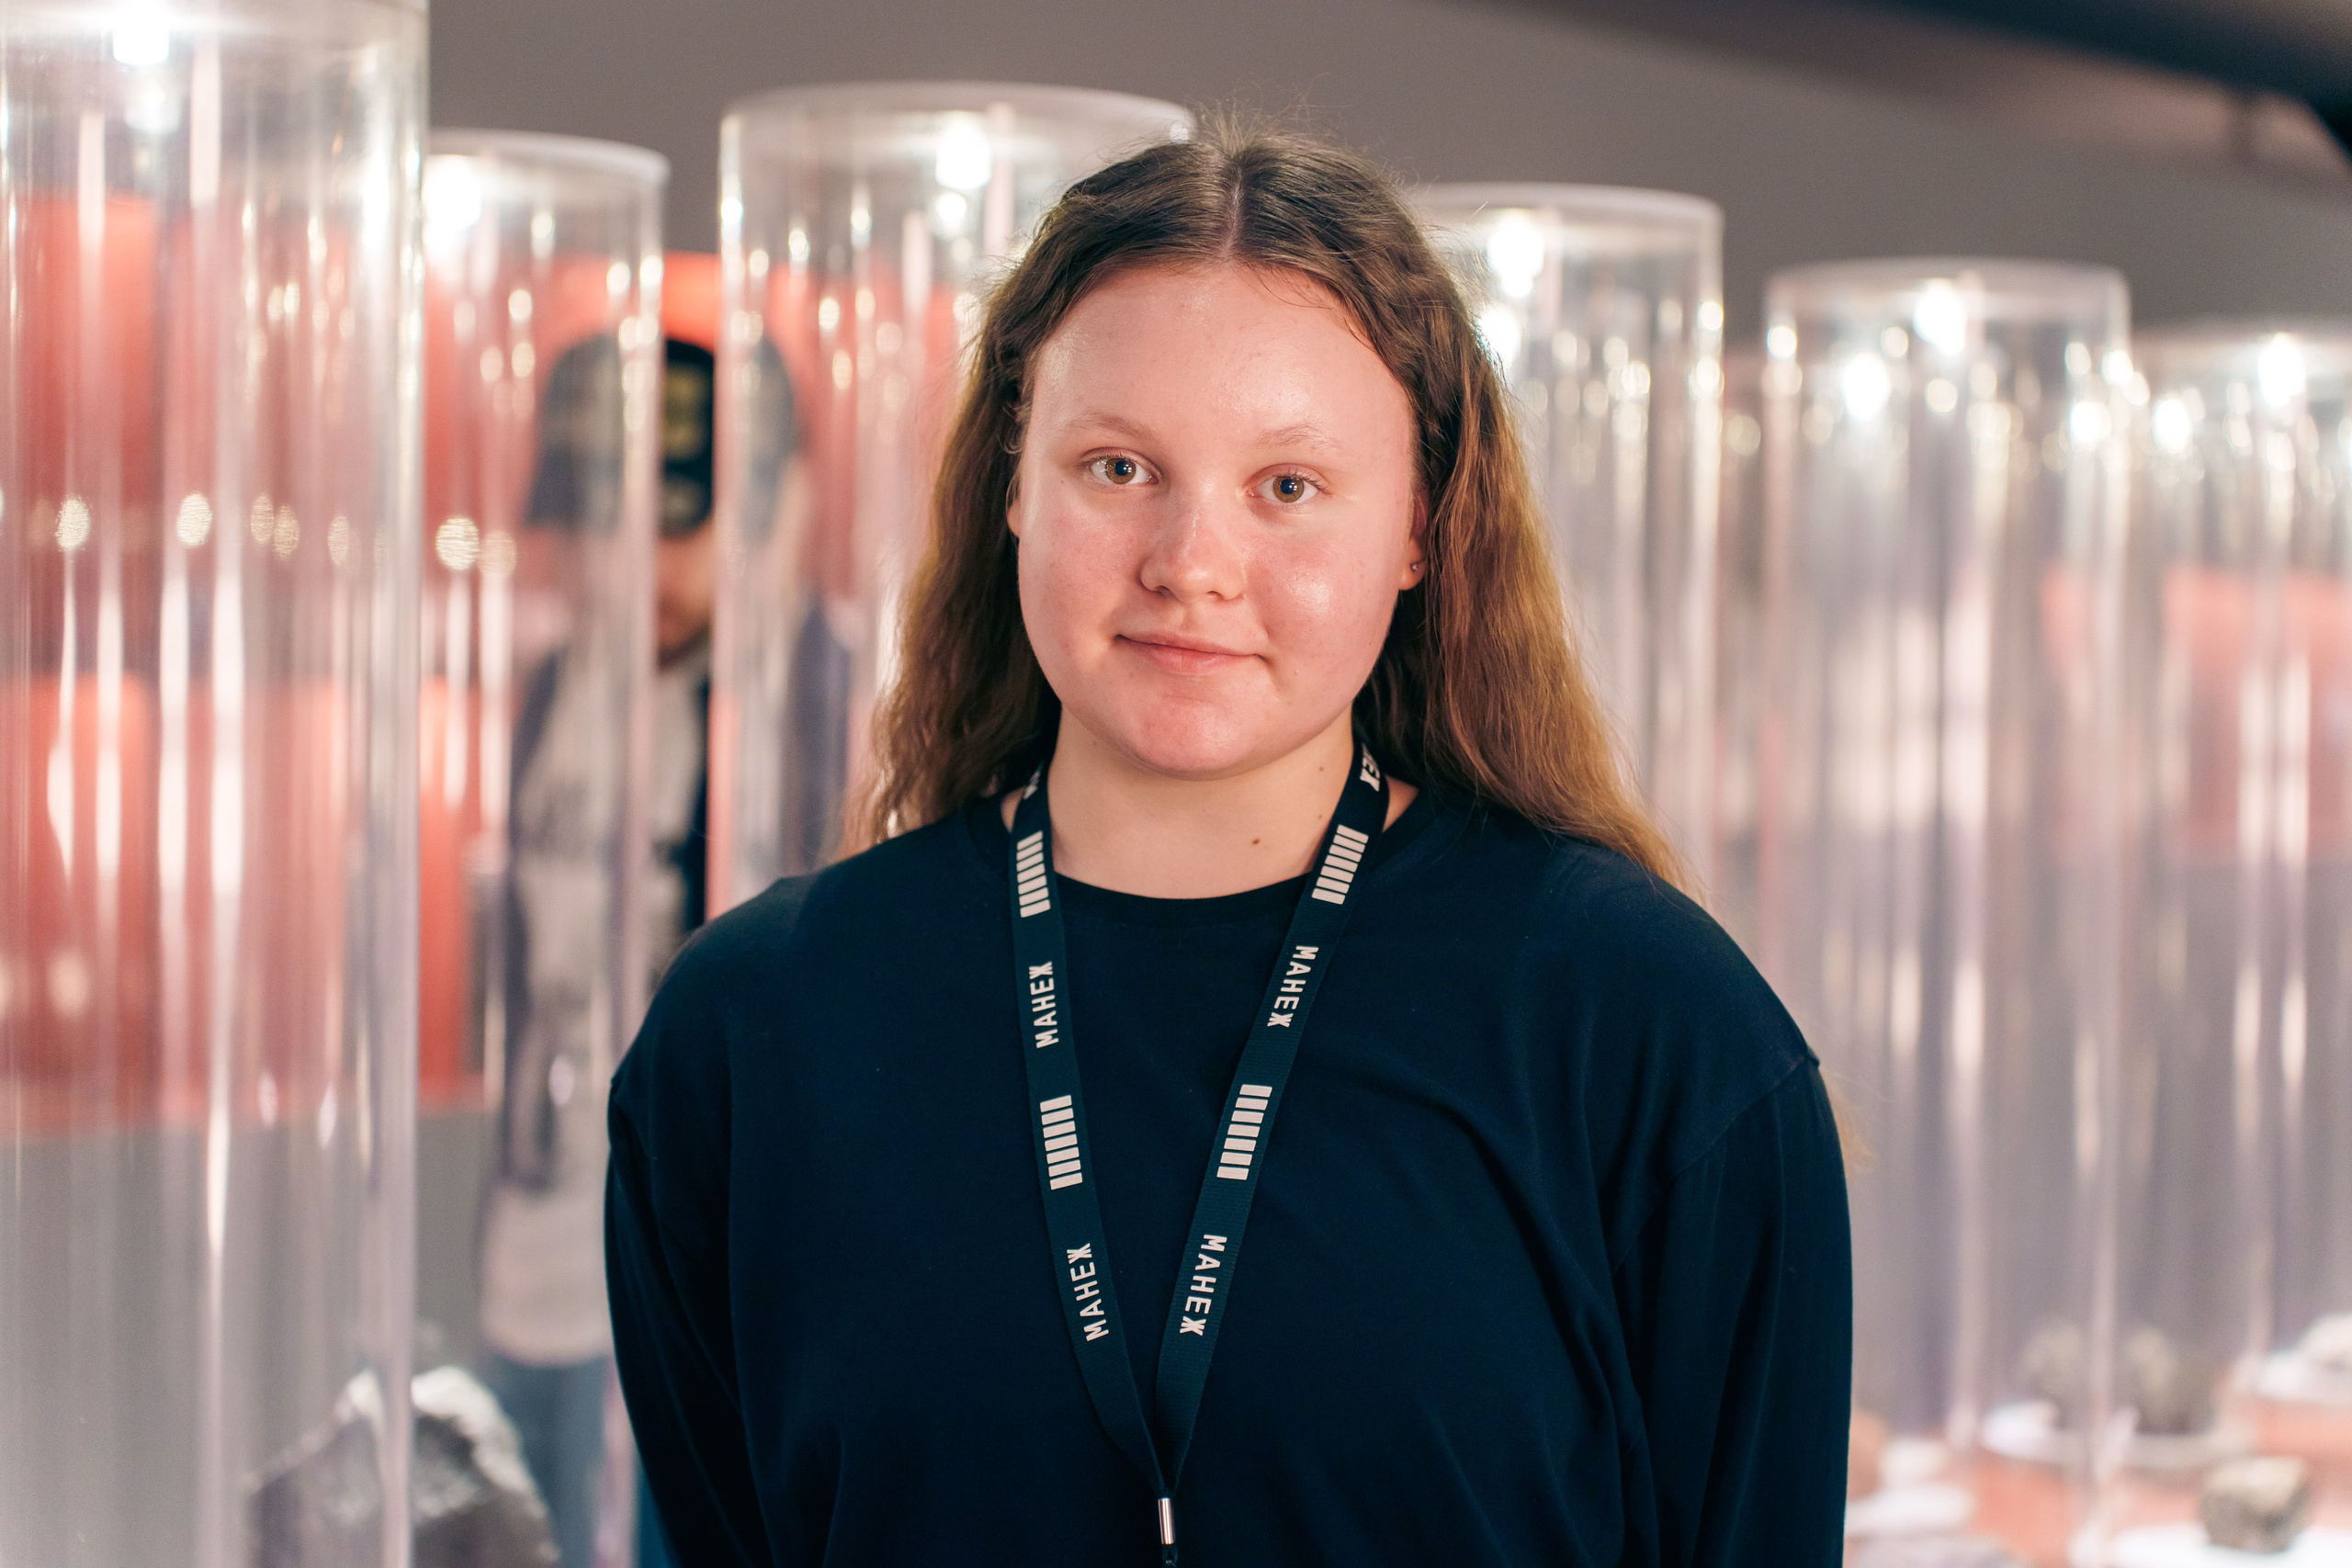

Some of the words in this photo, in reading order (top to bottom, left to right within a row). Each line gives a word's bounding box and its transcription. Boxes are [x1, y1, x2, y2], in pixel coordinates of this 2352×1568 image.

[1028, 961, 1059, 1049] МАНЕЖ
[1267, 945, 1319, 1028] МАНЕЖ
[1066, 1243, 1110, 1342] МАНЕЖ
[1179, 1234, 1227, 1337] МАНЕЖ
